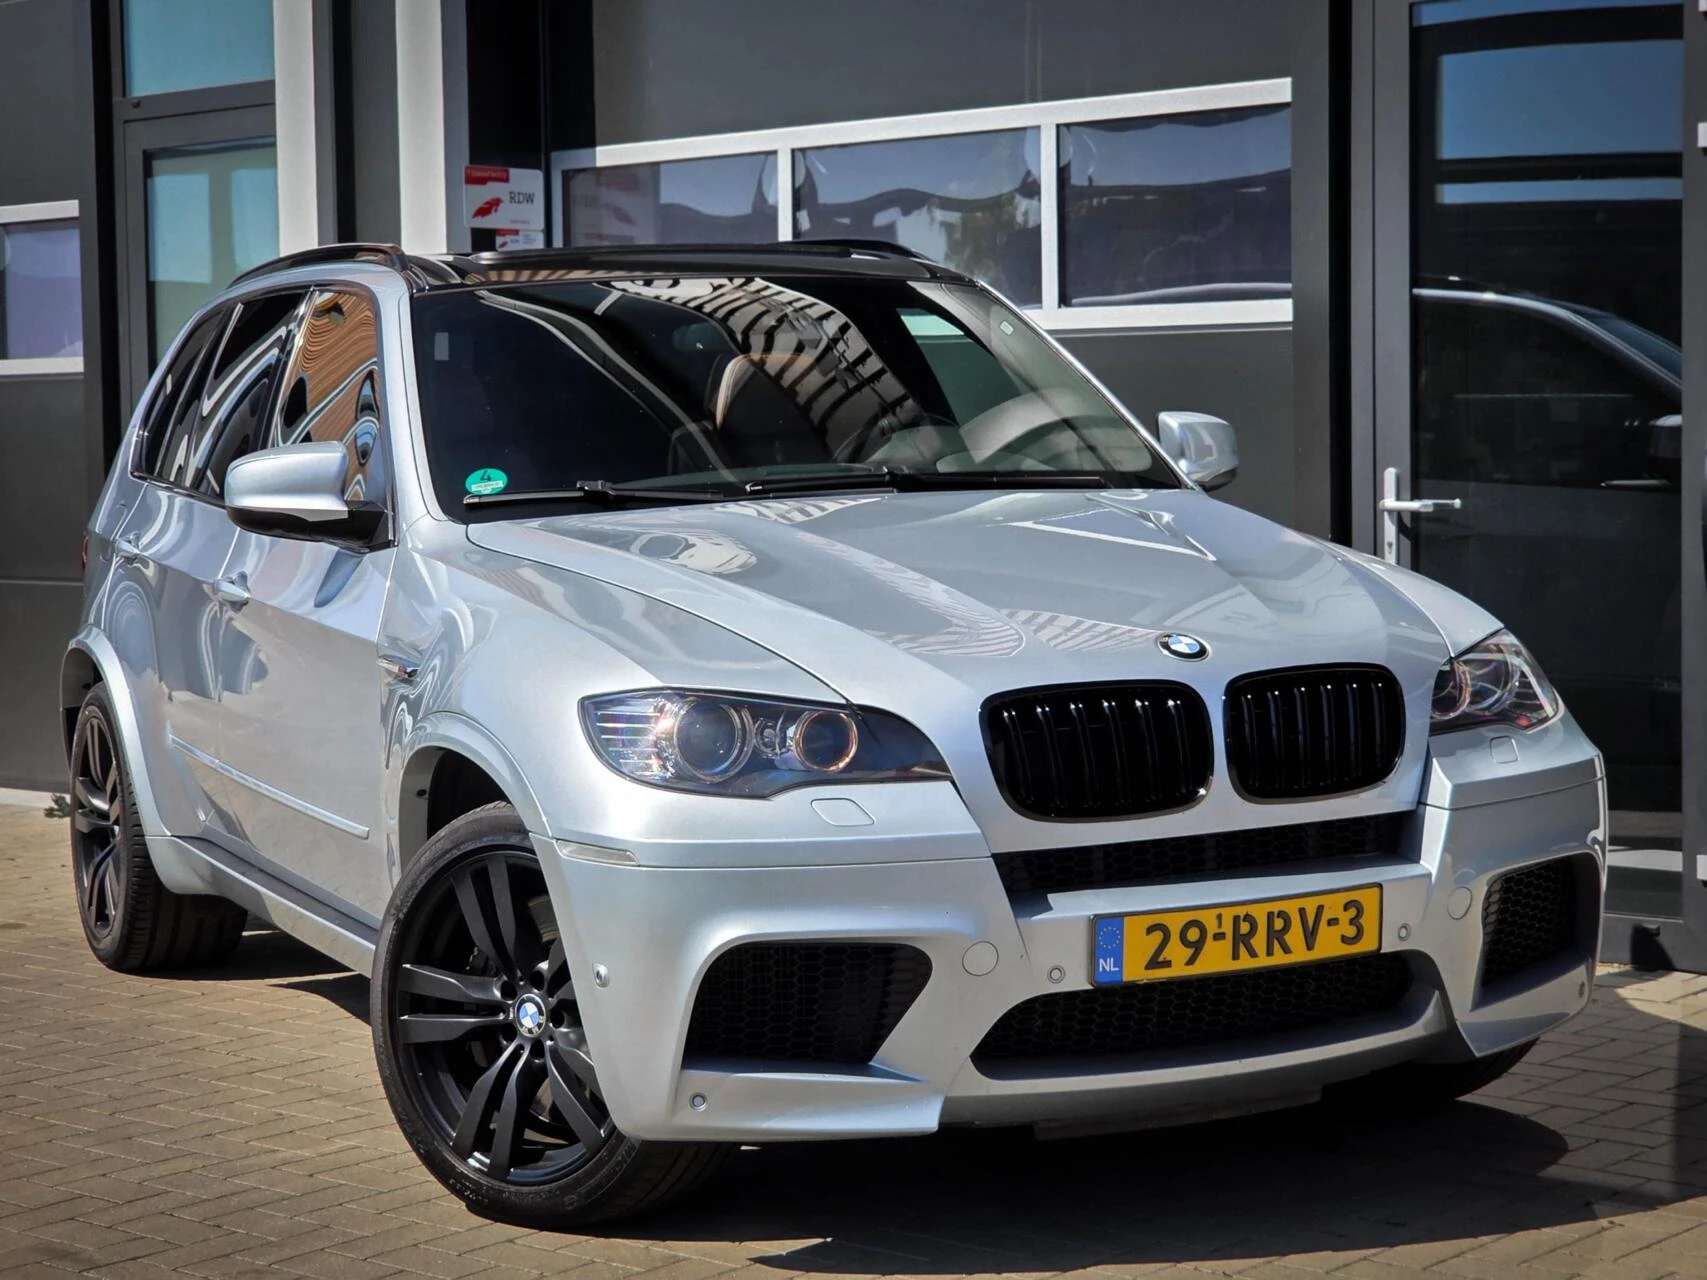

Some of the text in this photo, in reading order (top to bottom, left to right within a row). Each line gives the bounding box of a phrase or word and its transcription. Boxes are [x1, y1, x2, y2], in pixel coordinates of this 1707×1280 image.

[509, 191, 535, 205] RDW
[480, 469, 492, 481] 4
[1099, 957, 1119, 972] NL
